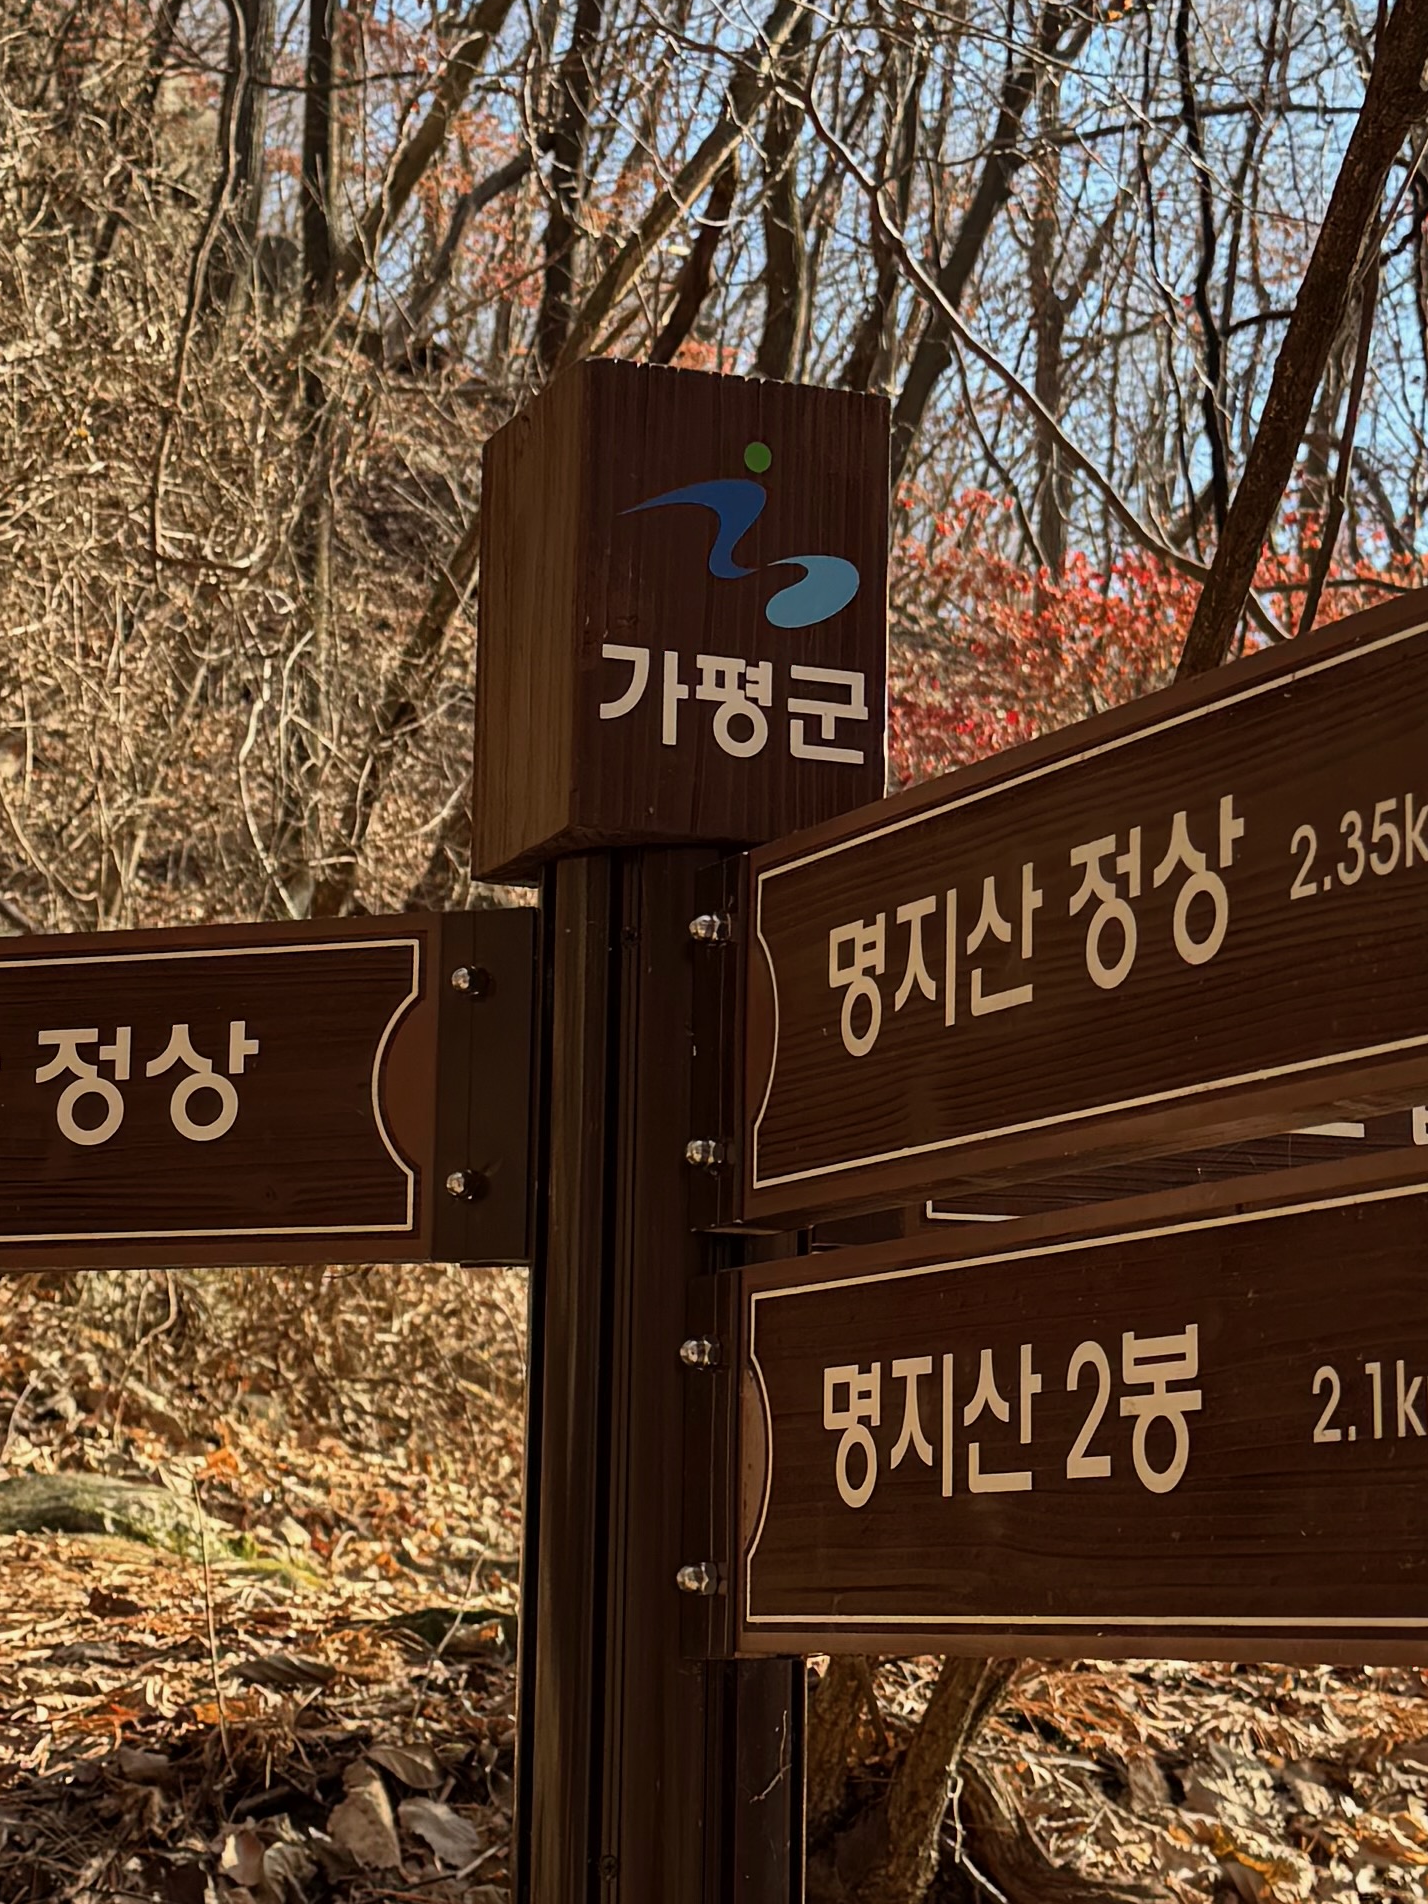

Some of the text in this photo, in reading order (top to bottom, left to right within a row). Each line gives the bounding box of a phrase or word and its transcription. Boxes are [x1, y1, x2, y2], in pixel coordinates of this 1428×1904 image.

[600, 644, 868, 764] 가평군
[827, 862, 1042, 1056] 명지산
[1070, 795, 1244, 989] 정상
[36, 1021, 259, 1145] 정상
[824, 1344, 1041, 1507] 명지산
[1067, 1324, 1201, 1493] 2봉
